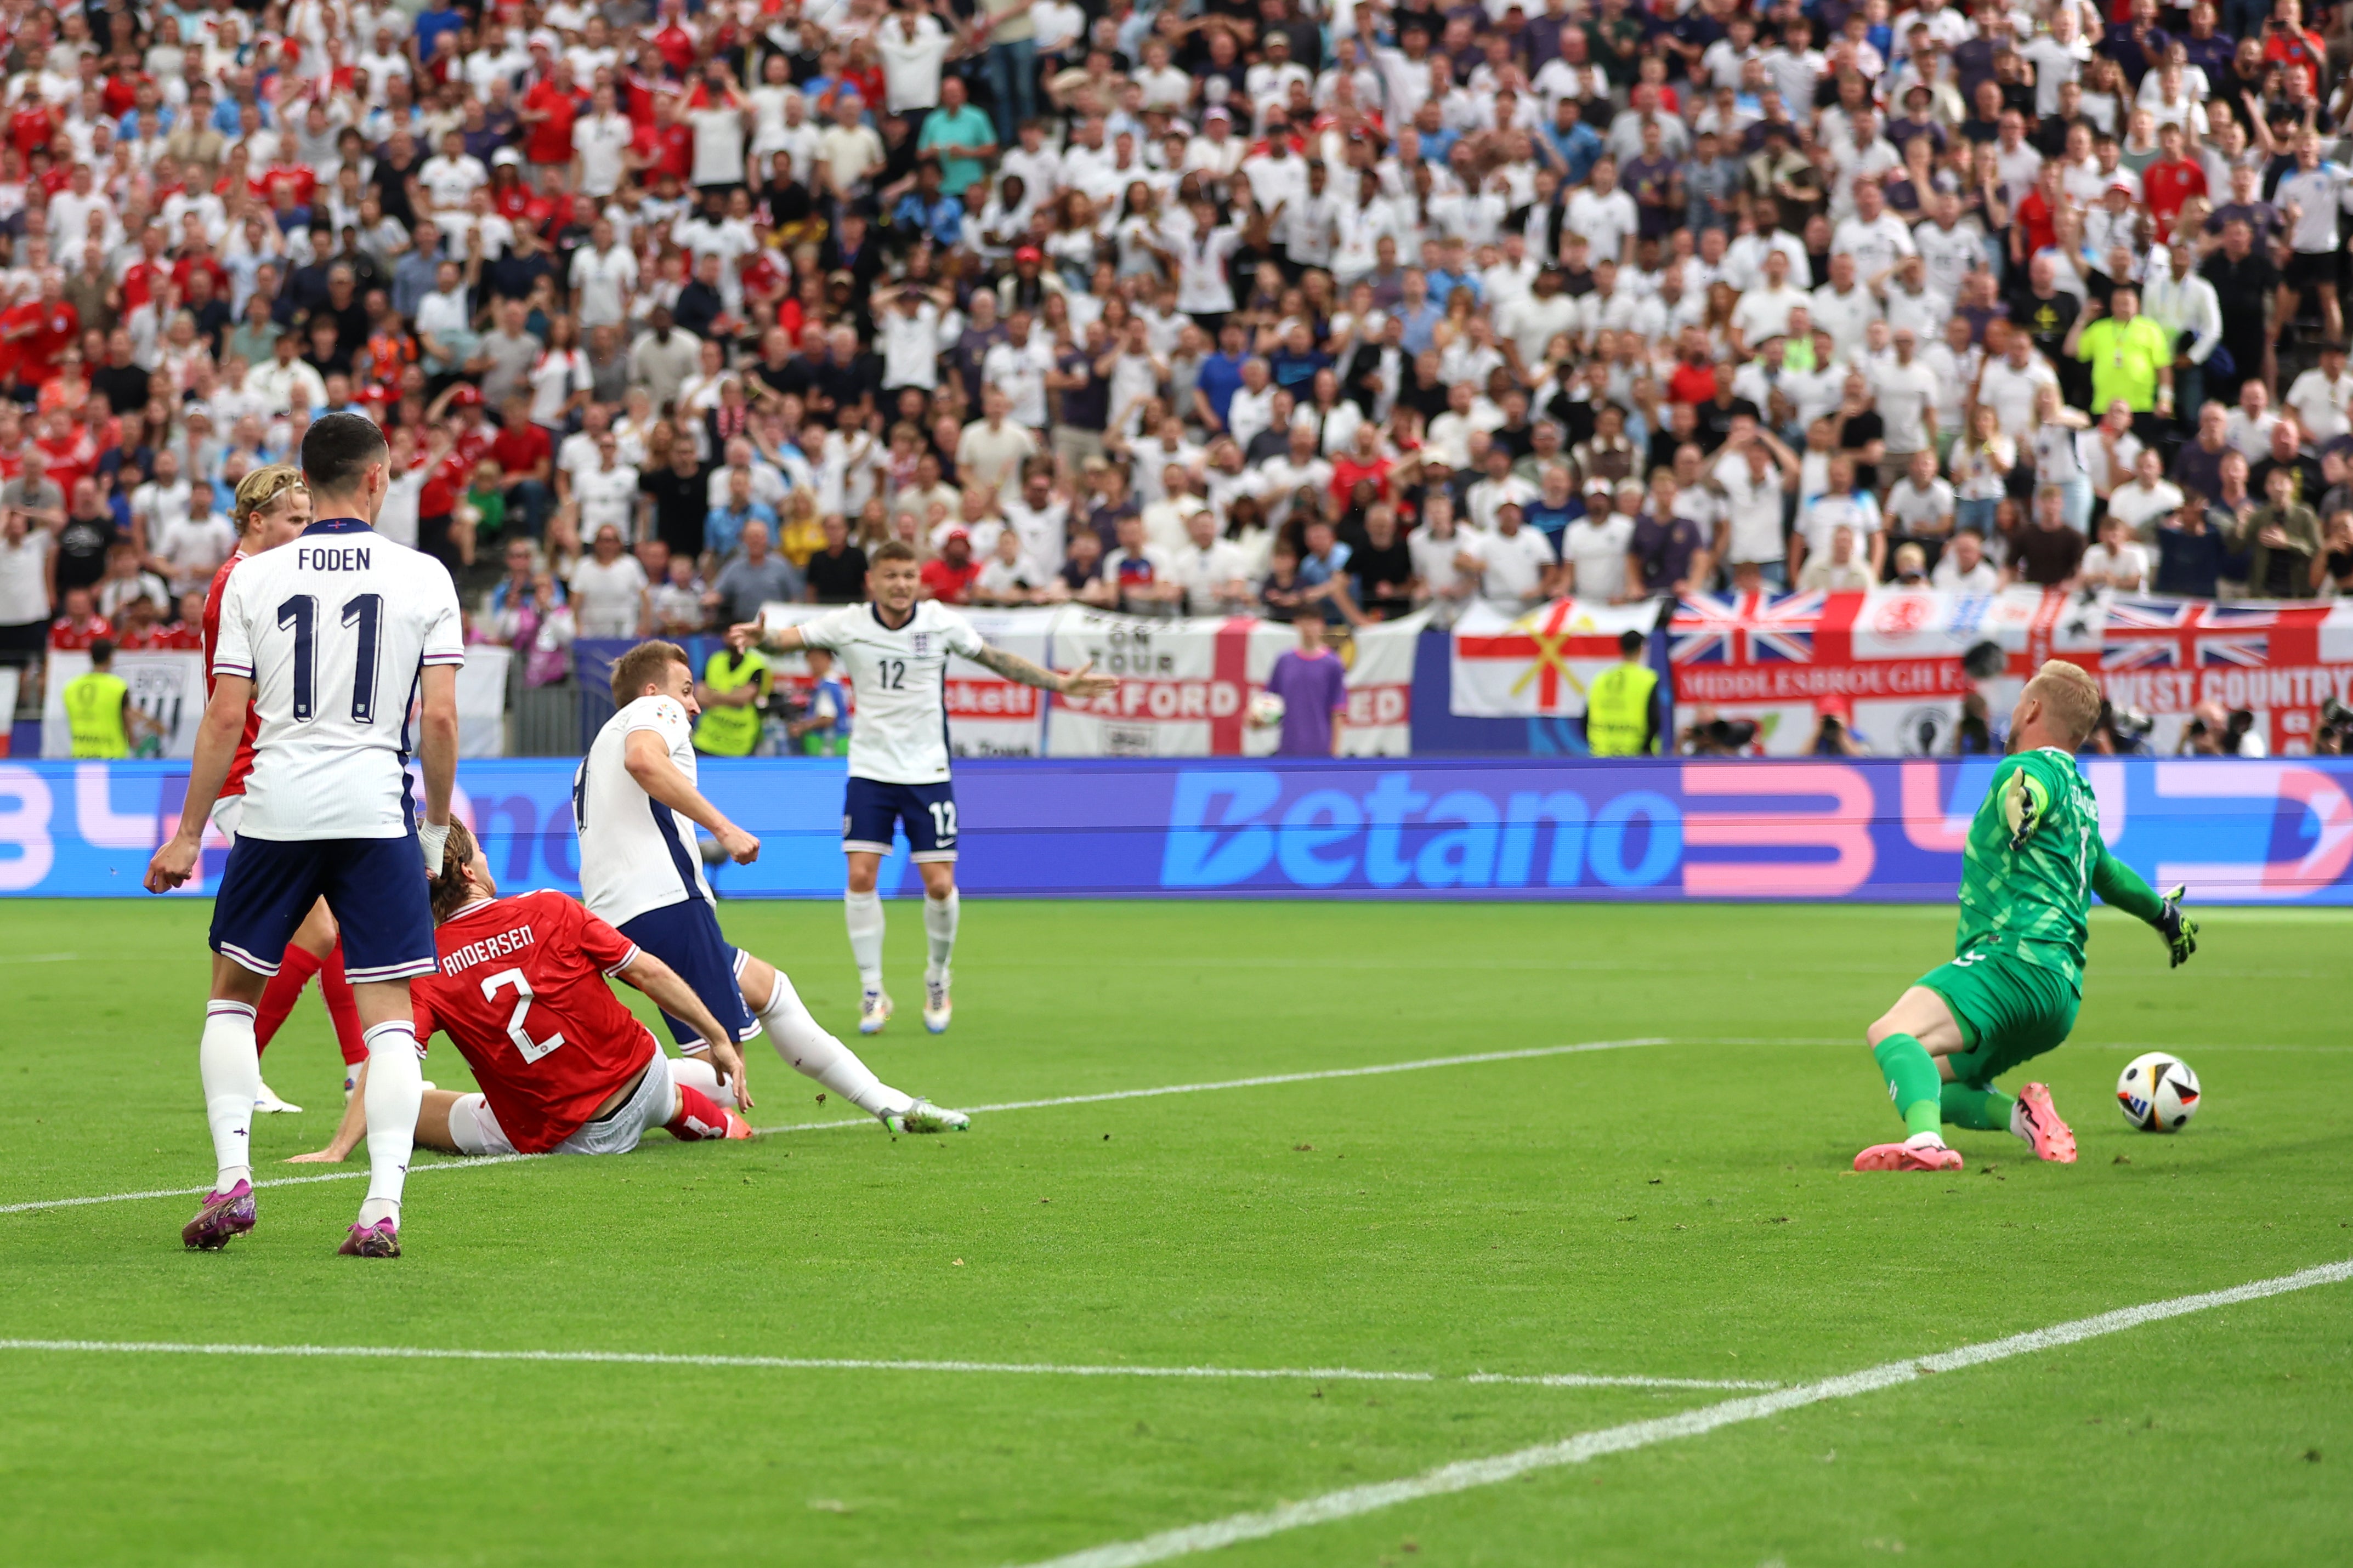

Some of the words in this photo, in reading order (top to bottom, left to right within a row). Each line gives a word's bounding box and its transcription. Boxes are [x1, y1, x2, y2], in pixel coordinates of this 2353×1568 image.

[298, 547, 371, 571] FODEN
[277, 593, 384, 725] 11
[878, 660, 905, 690] 12
[1682, 661, 1934, 700] MIDDLESBROUGH
[2104, 669, 2195, 713] WEST
[2201, 664, 2353, 714] COUNTRY
[928, 799, 958, 837] 12
[1160, 770, 1684, 889] Betano
[442, 924, 535, 978] ANDERSEN
[480, 967, 565, 1065] 2
